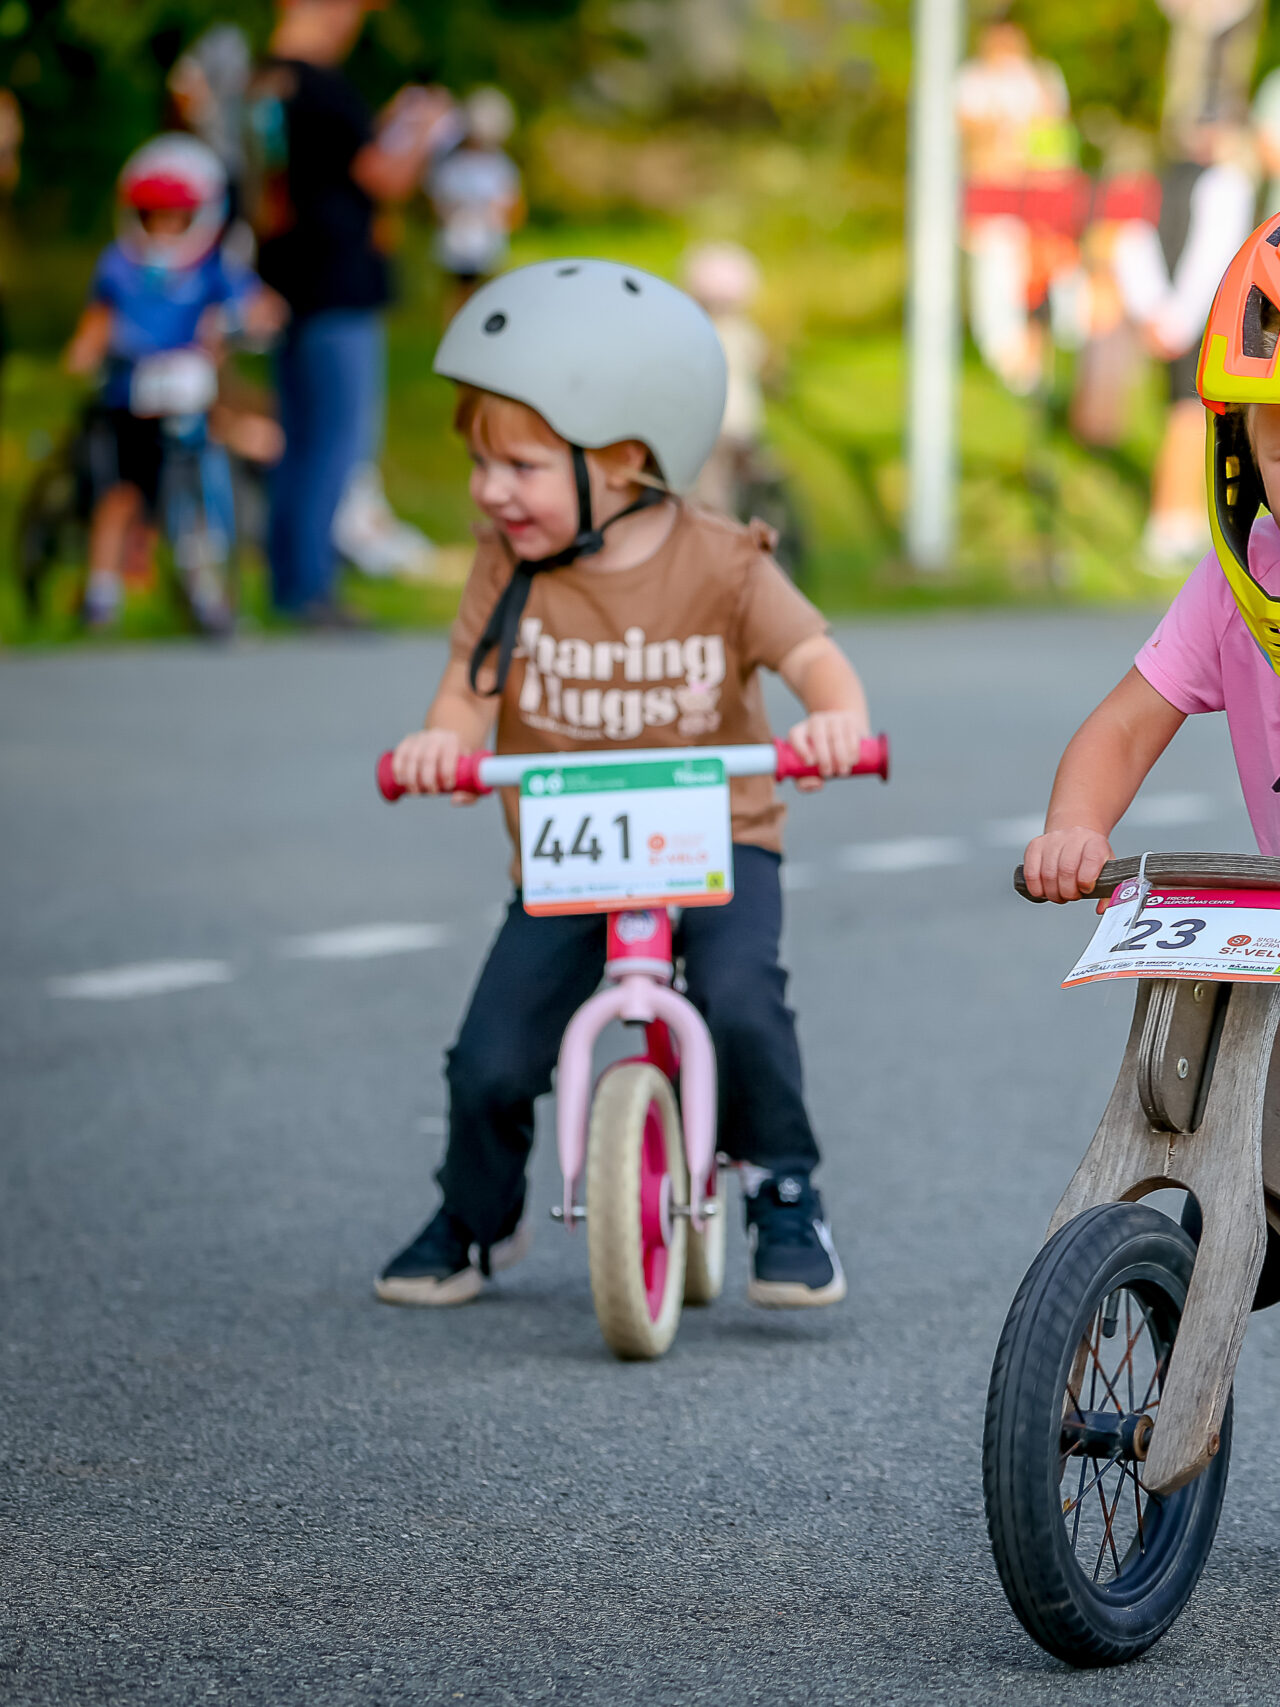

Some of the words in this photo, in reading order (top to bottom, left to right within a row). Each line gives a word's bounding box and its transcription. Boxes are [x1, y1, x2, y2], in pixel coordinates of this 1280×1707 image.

[512, 617, 725, 687] haring
[532, 813, 630, 864] 441
[1110, 919, 1206, 952] 23
